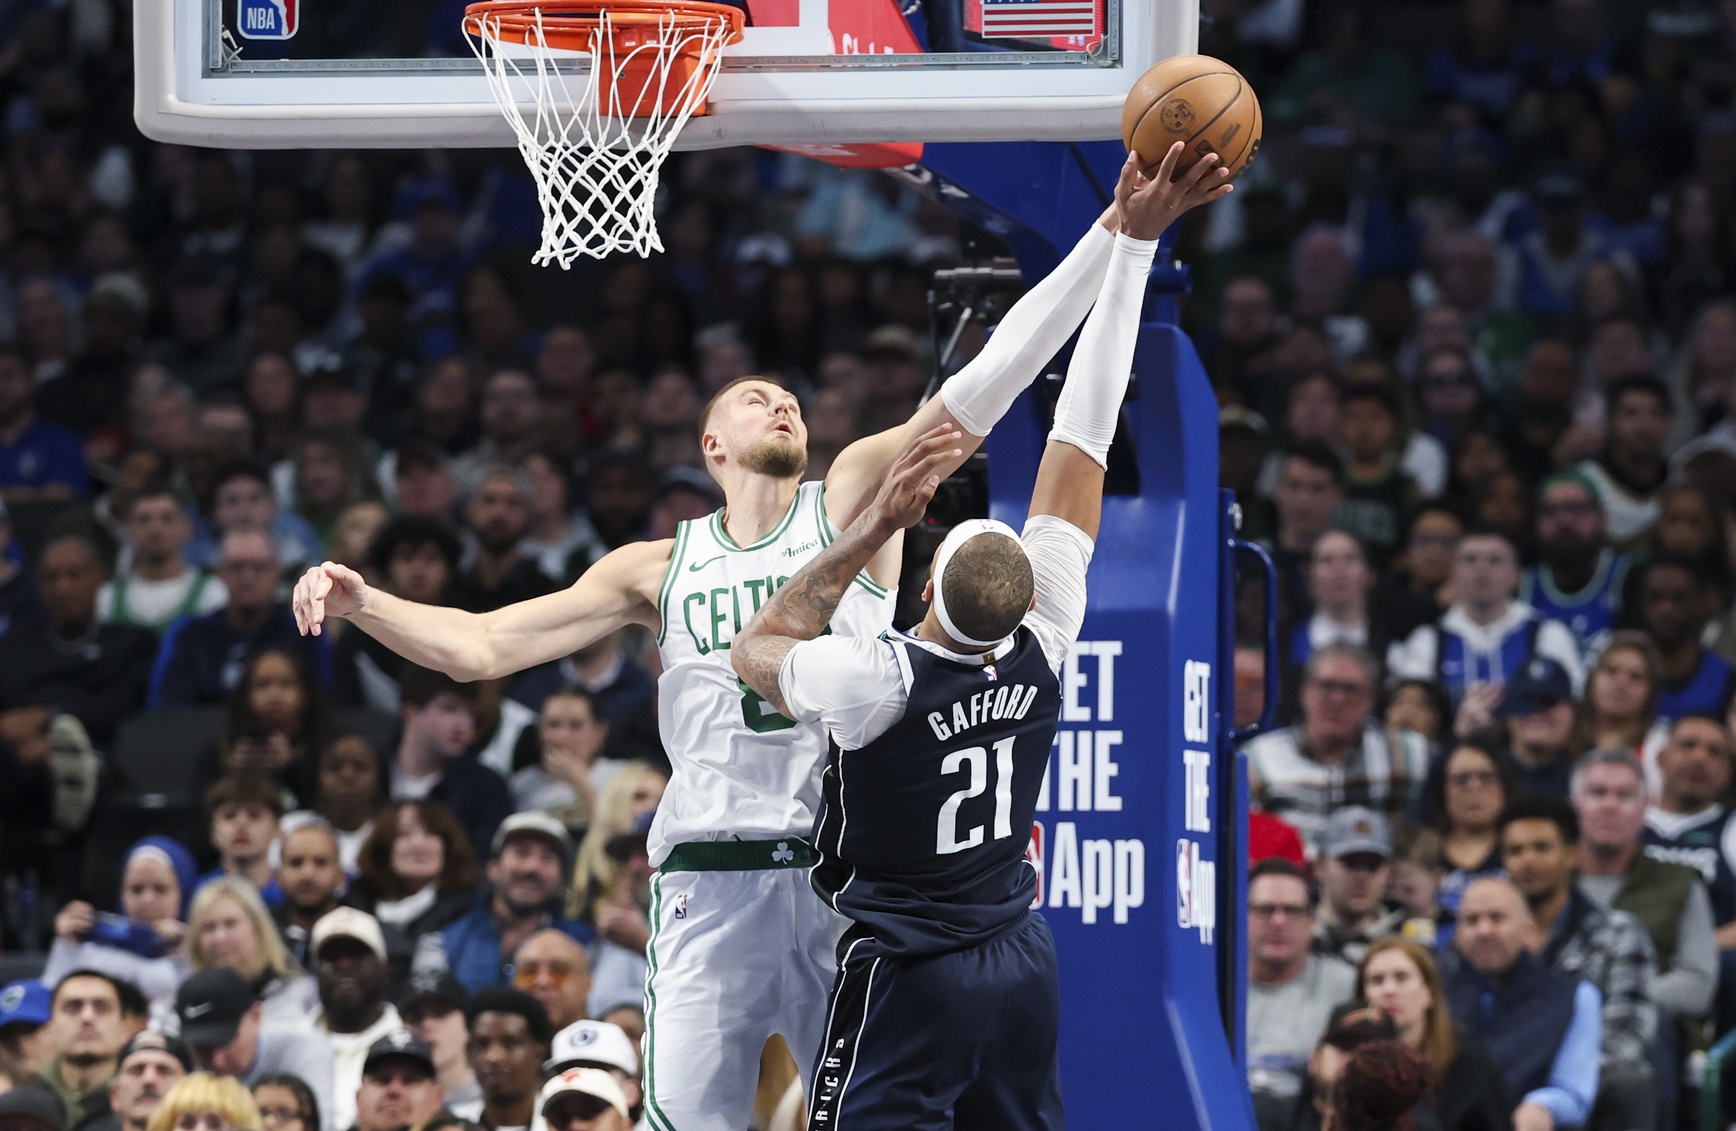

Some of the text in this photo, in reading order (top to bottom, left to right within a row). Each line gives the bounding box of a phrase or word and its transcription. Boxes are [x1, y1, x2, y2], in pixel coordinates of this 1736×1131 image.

[247, 8, 275, 29] NBA
[781, 539, 818, 558] Amica
[927, 684, 1038, 741] GAFFORD
[1059, 641, 1122, 722] ET
[936, 735, 1016, 855] 21
[1048, 822, 1145, 924] App
